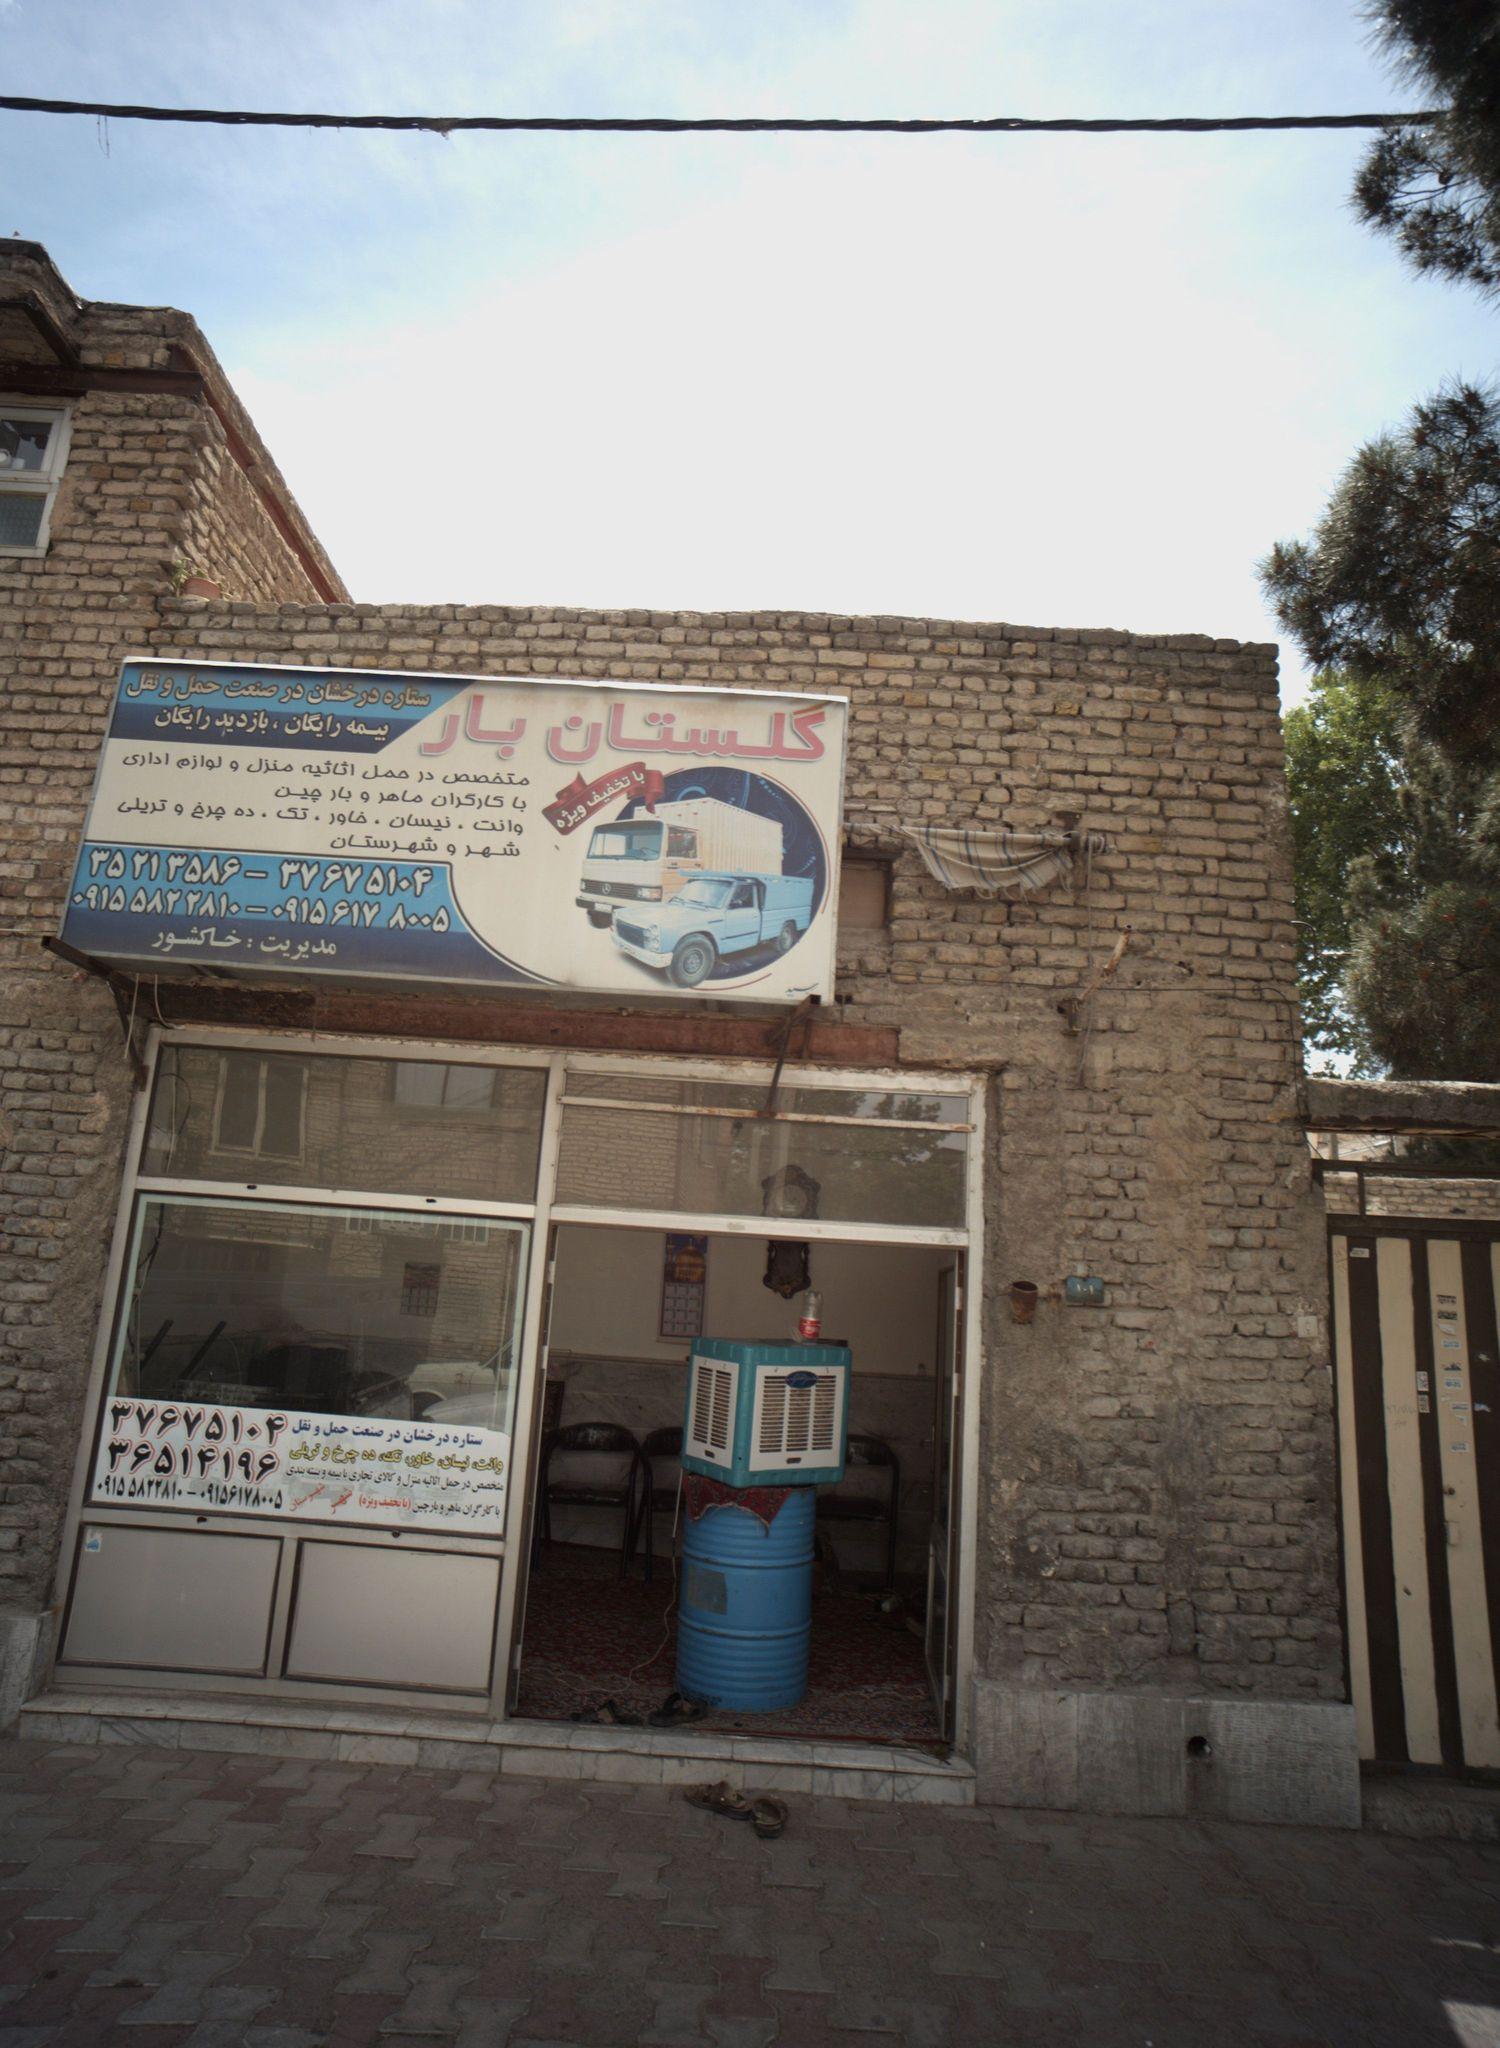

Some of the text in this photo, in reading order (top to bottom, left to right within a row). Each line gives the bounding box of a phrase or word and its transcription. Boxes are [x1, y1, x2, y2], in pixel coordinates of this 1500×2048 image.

[126, 672, 158, 697] نقل
[160, 680, 172, 697] و
[175, 675, 221, 699] حمل
[224, 680, 278, 698] صنعت
[280, 680, 303, 702] در
[383, 687, 430, 709] ستاره
[154, 704, 210, 730] رایگان
[214, 709, 270, 733] بازدید
[284, 712, 341, 738] رایگان
[346, 720, 389, 741] بیمه
[420, 693, 828, 763] گلستان بار
[122, 751, 530, 786] متخصص در حمل اثاثیه منزل و لوازم اداری
[275, 785, 322, 802] چین
[330, 786, 352, 801] بار
[360, 790, 370, 803] و
[378, 788, 423, 804] ماهر
[556, 770, 645, 829] با تخفیف ویژه
[117, 797, 168, 815] تریلی
[174, 803, 184, 816] و
[191, 801, 226, 821] چرخ
[234, 806, 255, 818] ده
[512, 795, 527, 812] با
[276, 806, 309, 821] تک
[329, 810, 368, 825] خاور
[389, 813, 451, 832] نیسان
[473, 818, 524, 836] وانت
[330, 834, 521, 858] شهر و شهرستان
[151, 926, 242, 952] خاکشور
[260, 936, 337, 960] مدیریت
[111, 1401, 287, 1446] ۳۷۶۷۵۱۰۴
[292, 1418, 311, 1435] نقل
[314, 1425, 320, 1436] و
[323, 1421, 348, 1437] حمل
[352, 1426, 384, 1438] صنعت
[387, 1427, 400, 1443] در
[452, 1431, 483, 1448] ستاره
[289, 1441, 321, 1461] تریلی
[321, 1446, 330, 1461] و
[331, 1444, 359, 1464] چرخ
[362, 1448, 376, 1460] ده
[107, 1439, 280, 1484] ۳۶۵۱۴۱۹۶
[349, 1470, 373, 1482] تجاری
[374, 1471, 396, 1484] کالای
[402, 1473, 421, 1488] منزل
[441, 1477, 460, 1491] حمل
[461, 1480, 471, 1490] در
[472, 1479, 503, 1493] متخصص
